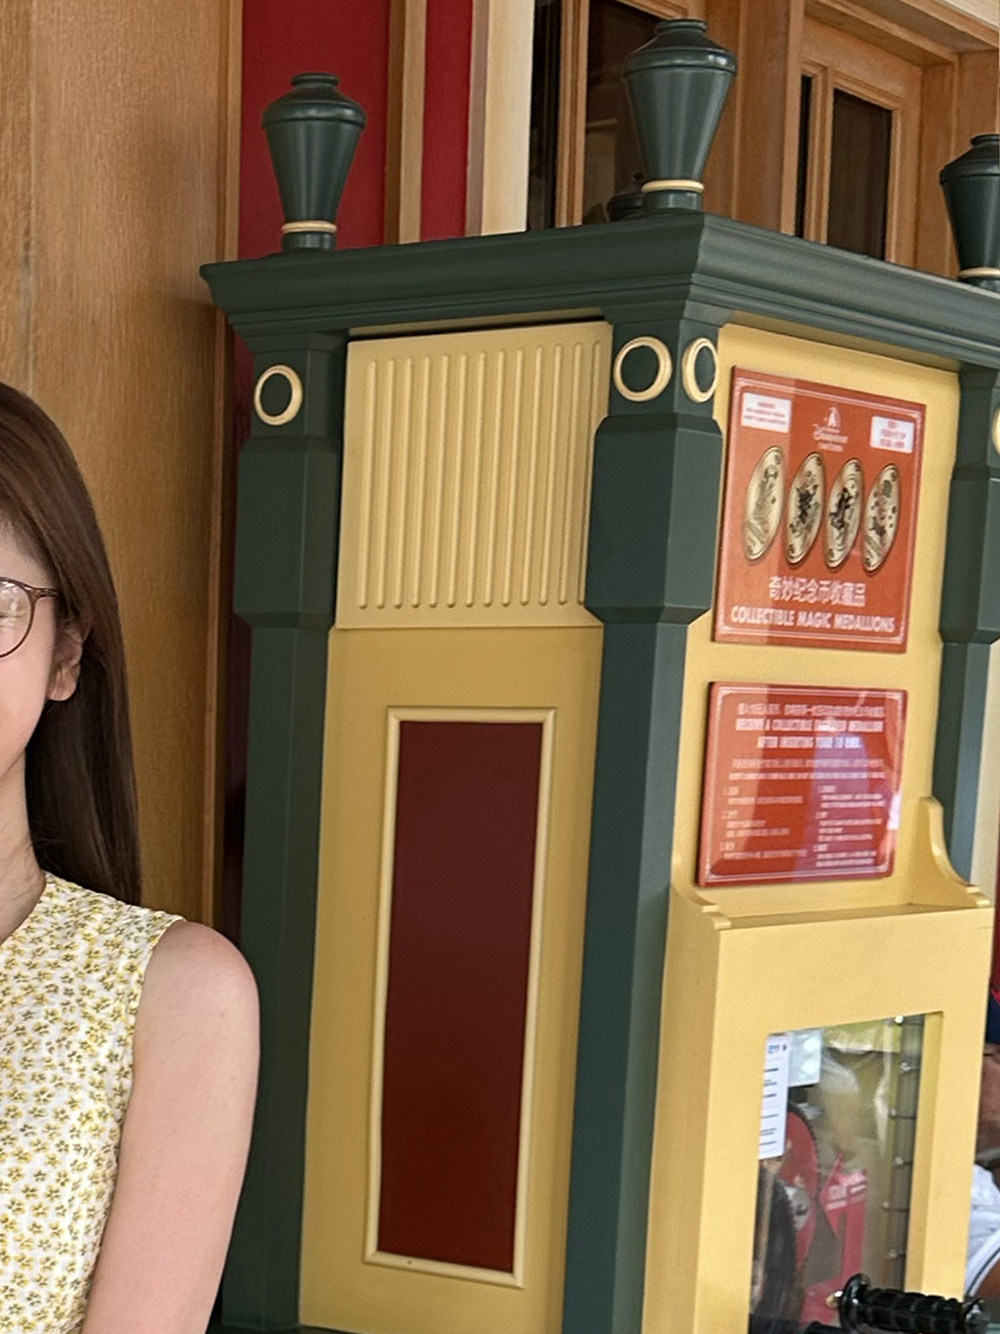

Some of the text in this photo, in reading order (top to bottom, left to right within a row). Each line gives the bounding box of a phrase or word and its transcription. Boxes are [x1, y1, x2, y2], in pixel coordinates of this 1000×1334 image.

[730, 605, 895, 632] COLLECTIBLE MAGIC MEDALLIONS
